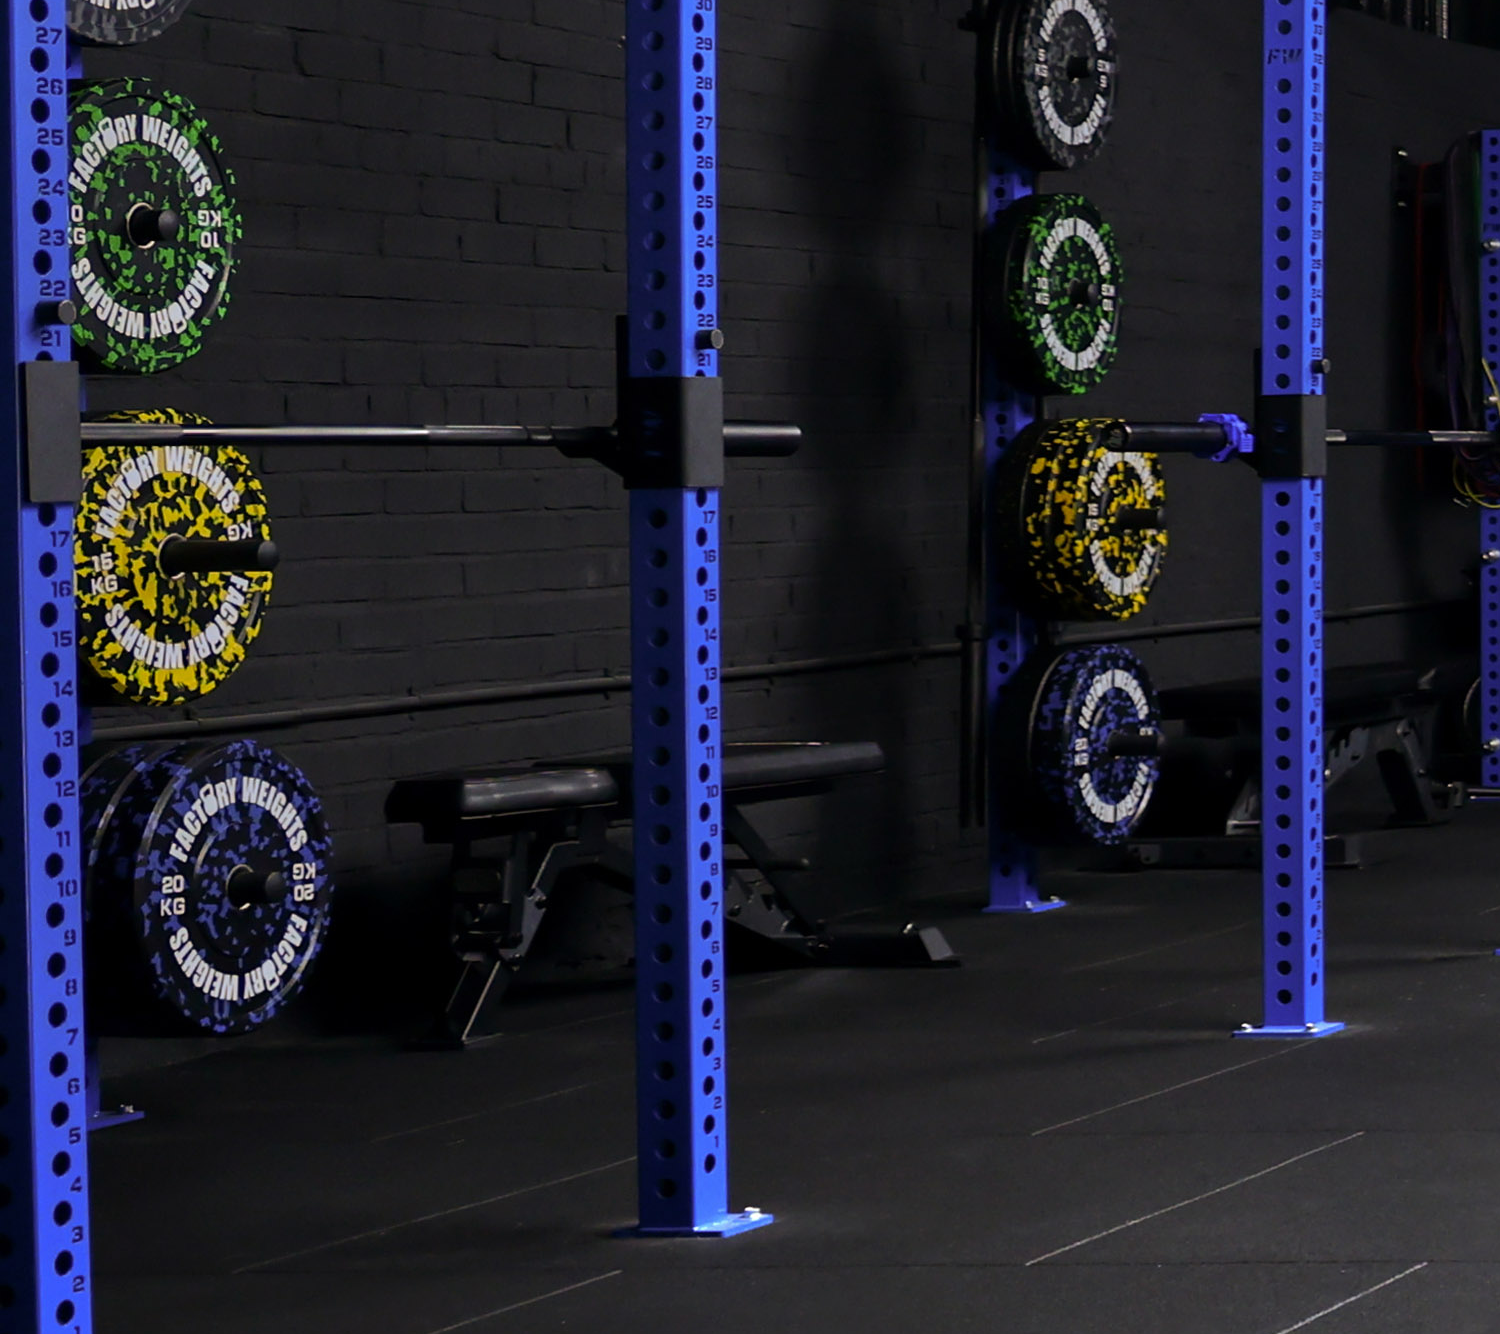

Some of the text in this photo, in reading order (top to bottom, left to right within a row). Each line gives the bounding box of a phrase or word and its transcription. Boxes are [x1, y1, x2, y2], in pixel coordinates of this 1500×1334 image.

[36, 26, 63, 47] 27
[695, 36, 713, 52] 29
[1267, 49, 1303, 65] FW
[36, 76, 63, 97] 26
[695, 75, 713, 91] 28
[695, 115, 714, 131] 27
[37, 127, 64, 148] 25
[68, 114, 212, 197] FACTORY WEIGHTS
[696, 155, 714, 171] 26
[38, 177, 65, 198] 24
[696, 194, 714, 210] 25
[68, 205, 86, 245] 0 G
[198, 210, 222, 248] 10 KG
[38, 228, 66, 249] 23
[696, 234, 714, 250] 24
[39, 278, 66, 299] 22
[697, 273, 714, 289] 23
[71, 257, 216, 339] FACTORY WEIGHTS
[697, 313, 715, 329] 22
[40, 329, 62, 348] 21
[696, 352, 711, 367] 21
[95, 446, 240, 539] FACTORY WEIGHTS
[50, 530, 71, 549] 17
[227, 523, 253, 541] KG
[91, 552, 119, 595] 15 KG
[51, 579, 73, 597] 16
[105, 575, 249, 669] FACTORY WEIGHTS
[52, 630, 73, 649] 15
[52, 679, 74, 697] 14
[53, 729, 75, 747] 13
[55, 779, 76, 797] 12
[169, 776, 309, 863] FACTORY WEIGHTS
[56, 830, 71, 847] 11
[57, 879, 78, 897] 10
[292, 862, 316, 902] 20 KG
[160, 875, 186, 917] 20 KG
[63, 928, 77, 947] 9
[169, 913, 308, 1001] FACTORY WEIGHTS
[65, 978, 78, 997] 8
[65, 1027, 79, 1046] 7
[67, 1077, 80, 1096] 6
[68, 1126, 82, 1145] 5
[69, 1175, 83, 1193] 4
[71, 1225, 84, 1244] 3
[72, 1274, 85, 1293] 2
